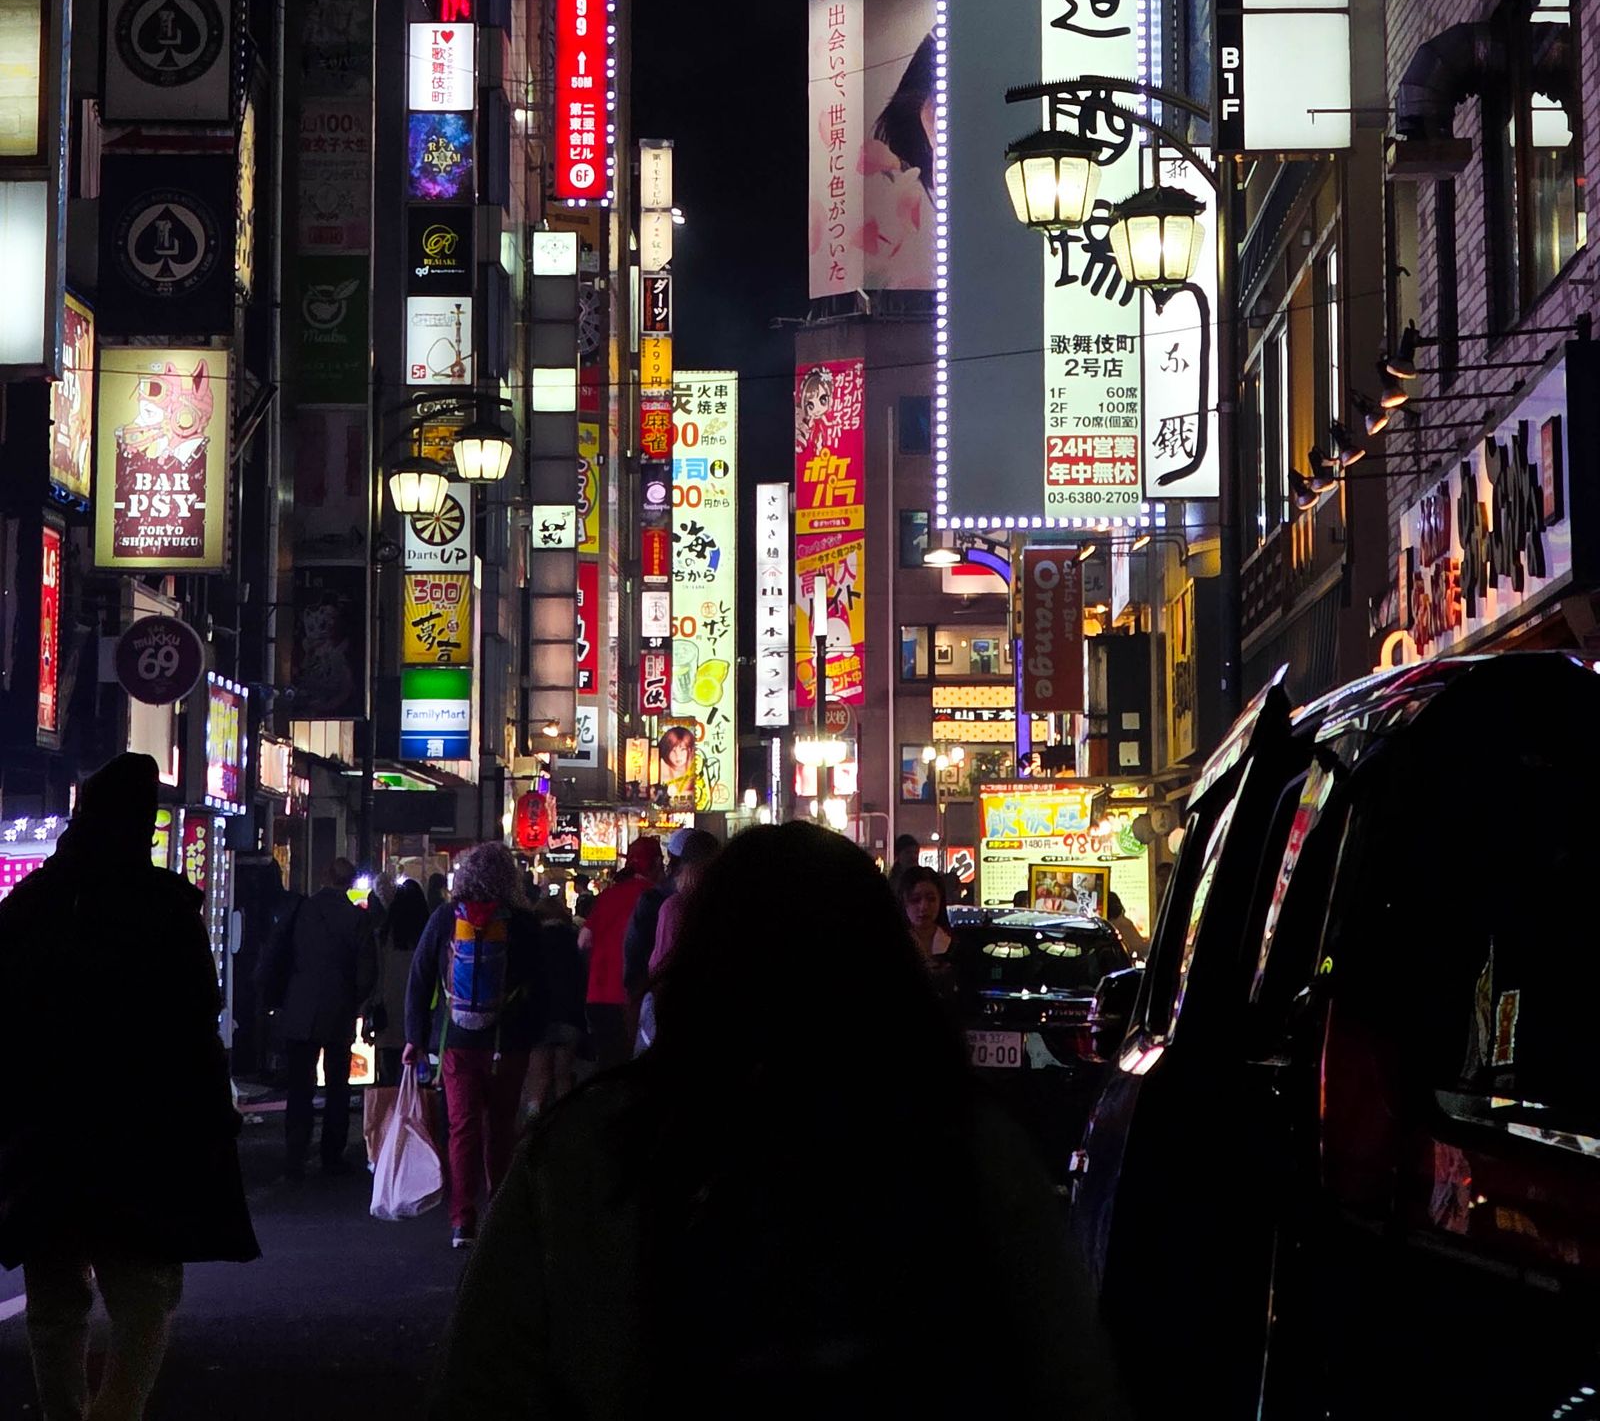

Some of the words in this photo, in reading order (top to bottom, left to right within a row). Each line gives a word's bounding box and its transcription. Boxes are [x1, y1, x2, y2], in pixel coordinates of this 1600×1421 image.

[432, 47, 447, 104] 歌舞伎町
[827, 4, 848, 281] 出会いで、世界に色がついた
[575, 168, 589, 184] 6F
[653, 279, 669, 322] ダーツ
[1050, 335, 1135, 355] 歌舞伎町
[1064, 358, 1123, 378] 2号店
[842, 370, 855, 430] コンカフェ
[852, 362, 864, 430] キャバクラ
[1050, 388, 1066, 399] 1F
[1106, 387, 1138, 399] 60席
[832, 372, 846, 449] ガールズバー
[1050, 403, 1068, 414] 2F
[1098, 402, 1138, 414] 100席
[642, 412, 668, 452] 麻雀
[1050, 417, 1068, 428] 3F
[1074, 416, 1138, 429] 70席(個室)
[1049, 437, 1136, 458] 24H営業
[135, 472, 191, 491] BAR
[1049, 462, 1136, 484] 年中無休
[138, 524, 184, 536] TOKYO
[122, 536, 200, 547] SHINJYUKU
[408, 550, 439, 561] Darts
[440, 547, 468, 565] UP
[413, 579, 461, 605] 300
[1028, 560, 1061, 700] Orange
[649, 638, 663, 648] 3F
[138, 645, 180, 680] 69
[406, 709, 466, 721] FamilyMart
[427, 739, 445, 757] 酒
